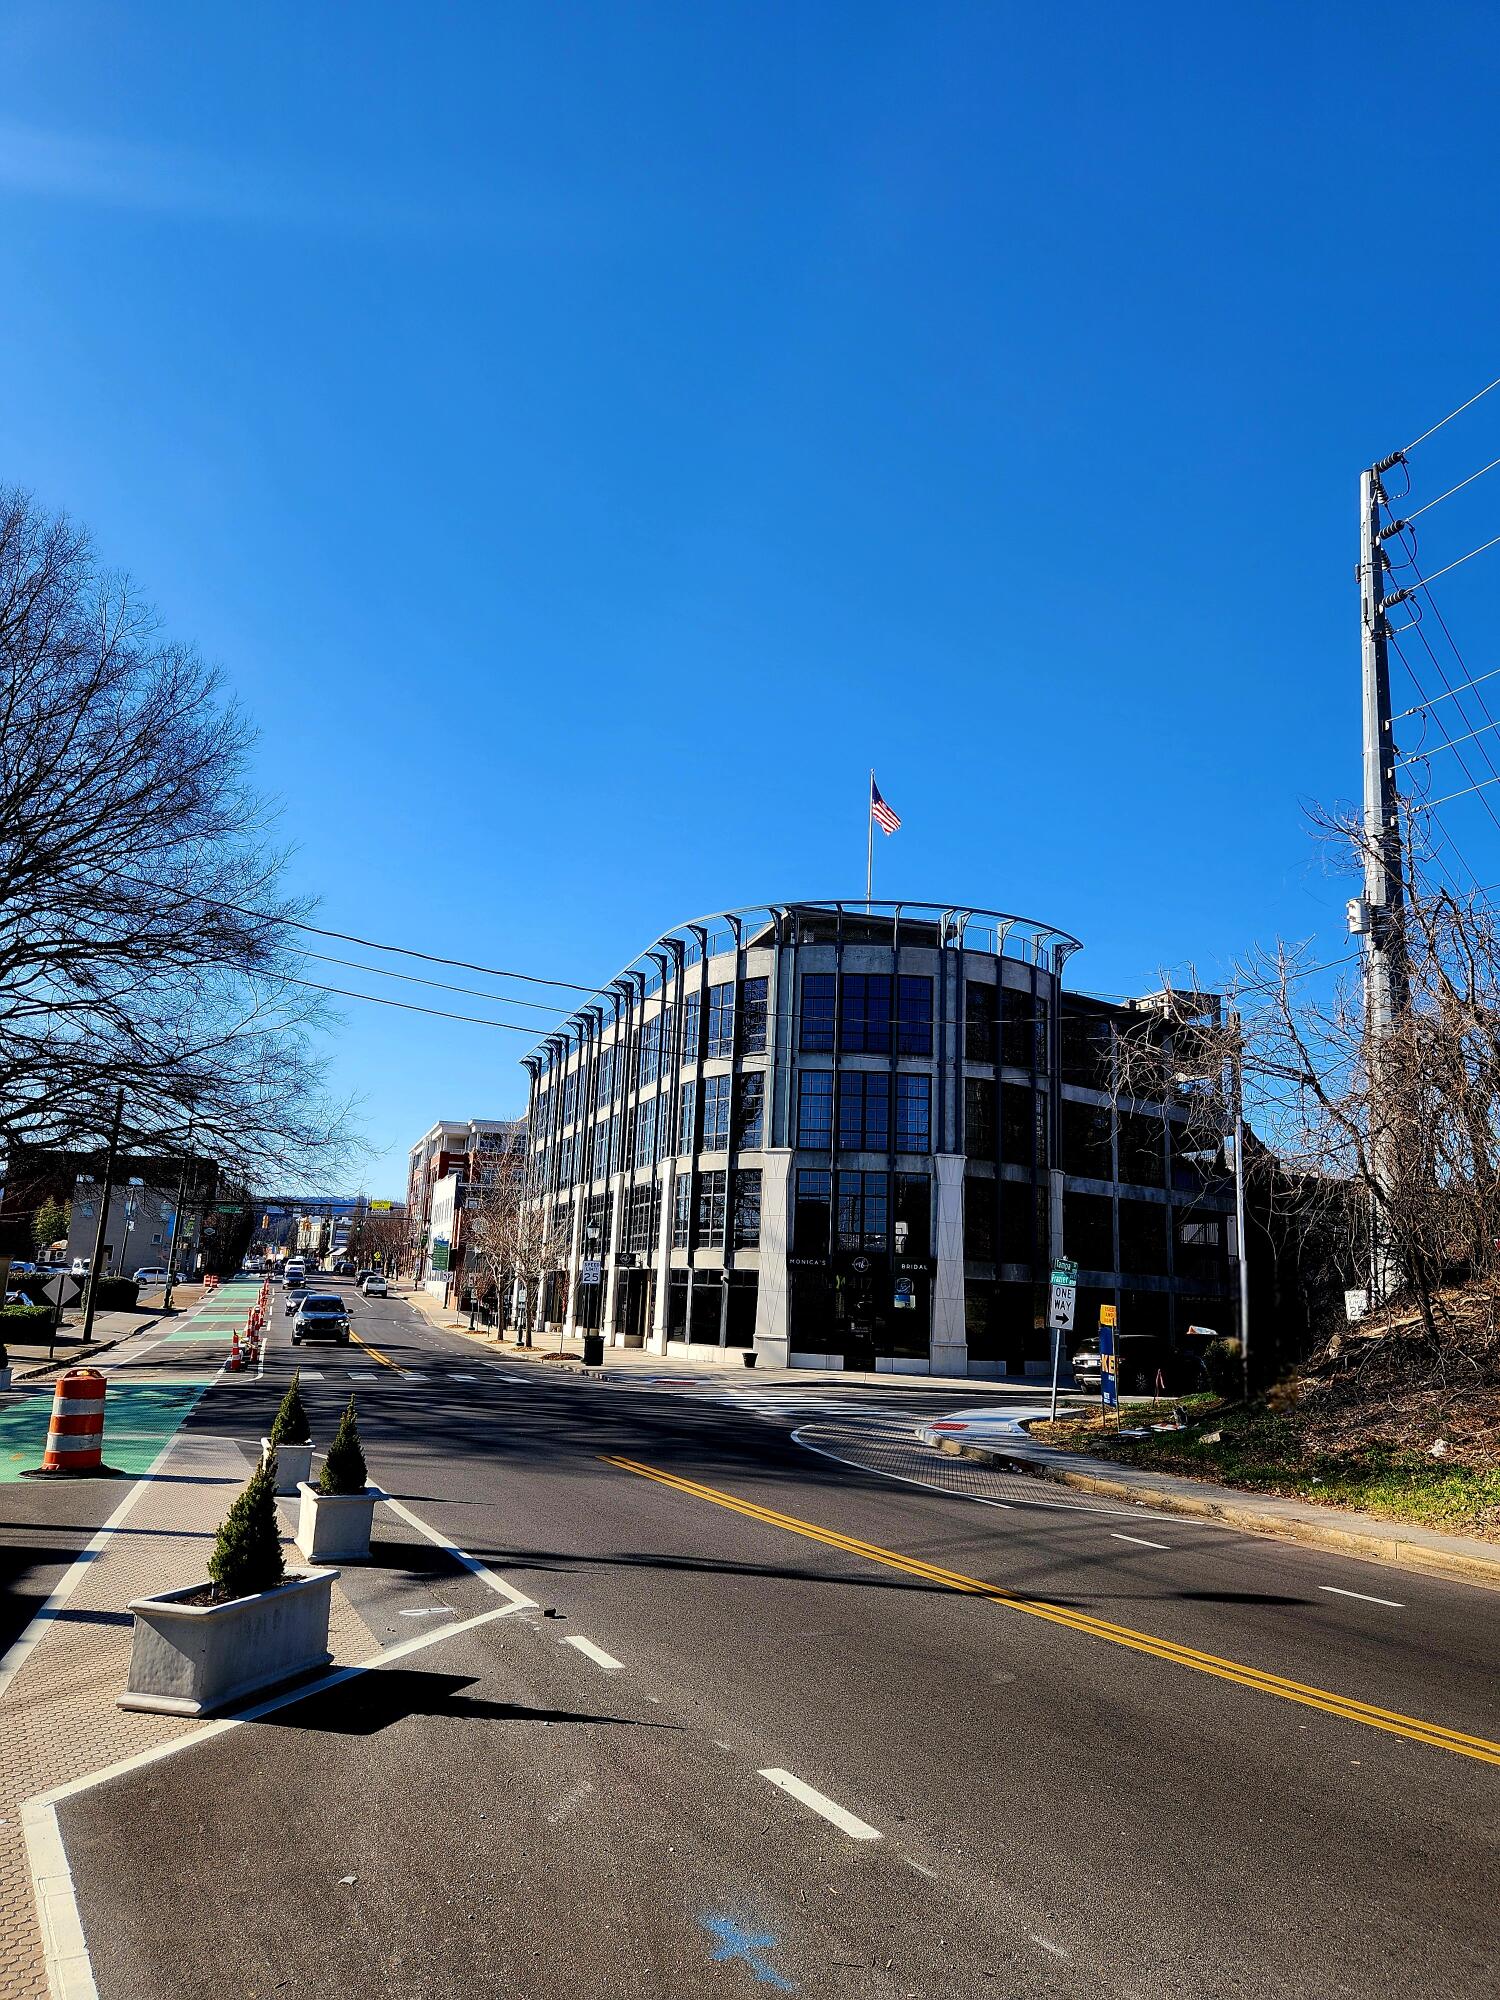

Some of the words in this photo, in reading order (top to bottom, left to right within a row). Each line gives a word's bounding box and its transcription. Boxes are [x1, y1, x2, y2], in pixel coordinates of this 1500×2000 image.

[584, 1272, 599, 1282] 25
[1055, 1287, 1072, 1299] ONE
[1054, 1299, 1072, 1311] WAY
